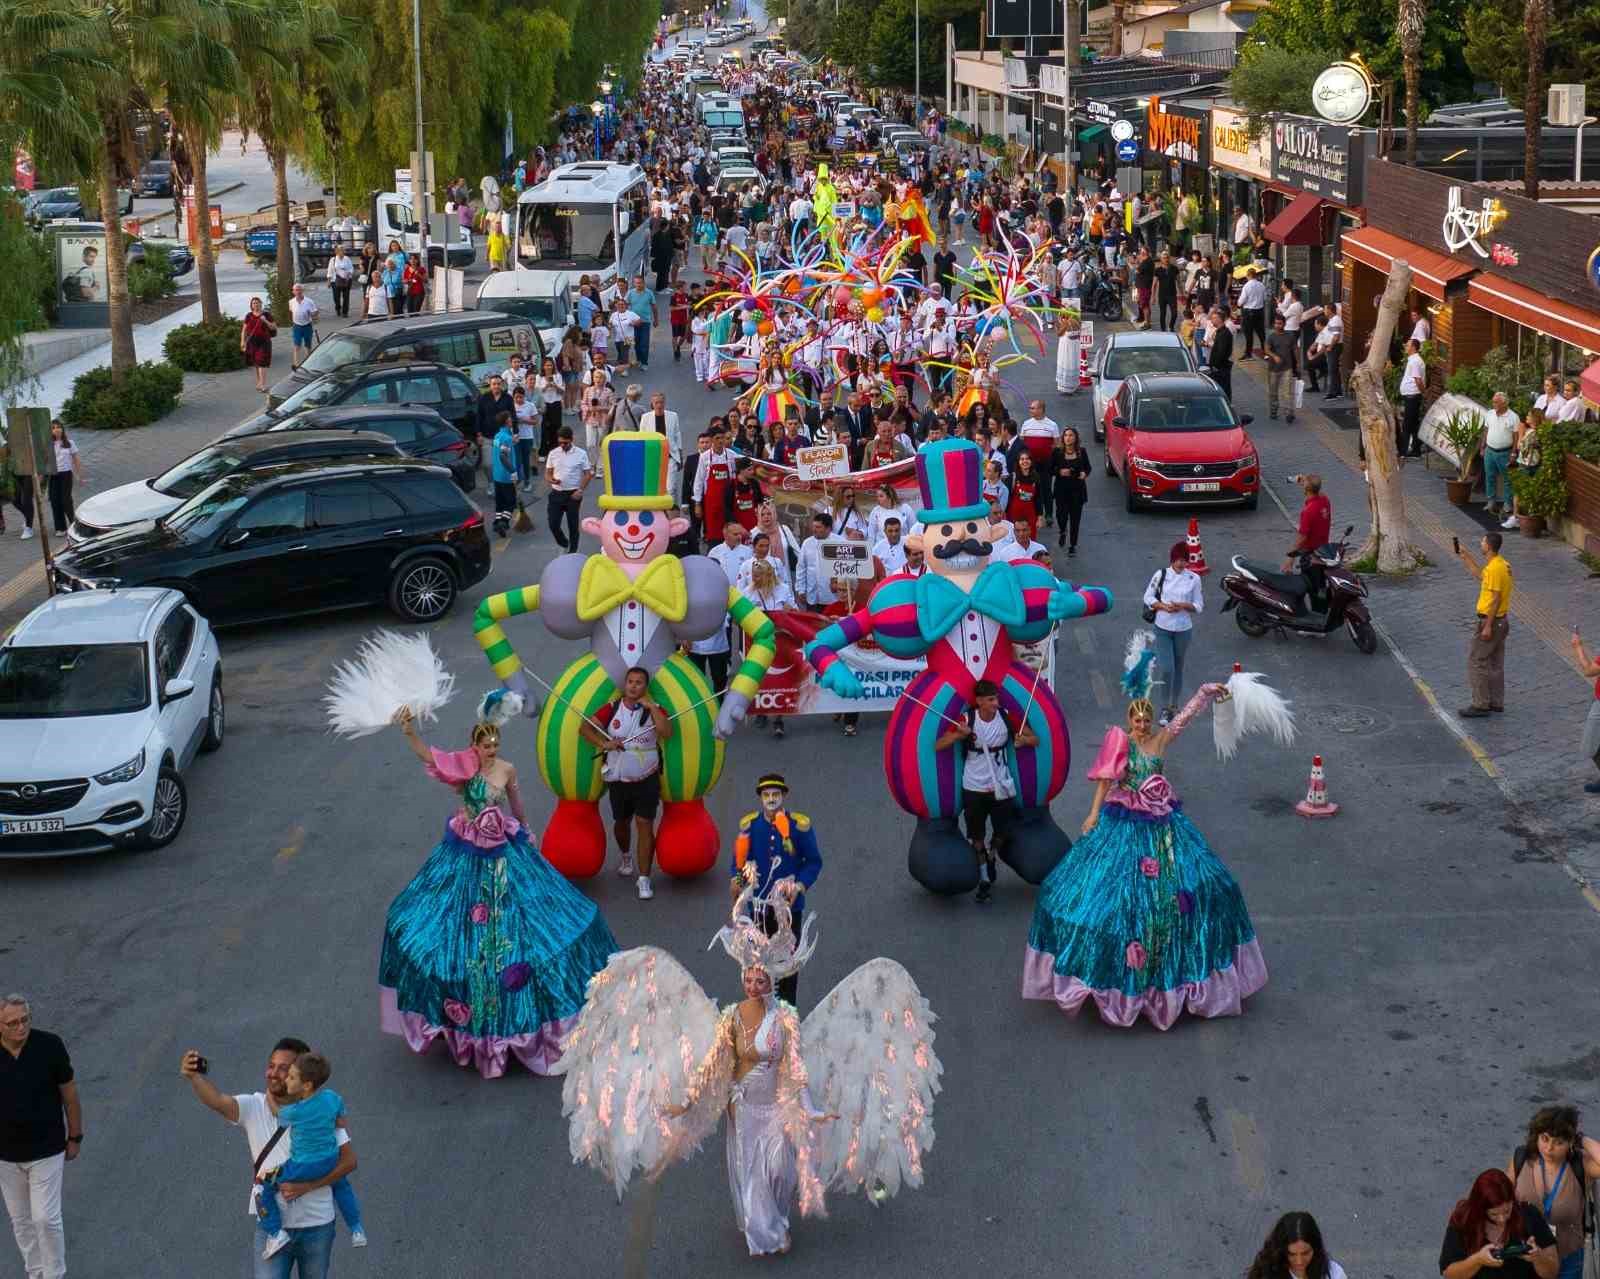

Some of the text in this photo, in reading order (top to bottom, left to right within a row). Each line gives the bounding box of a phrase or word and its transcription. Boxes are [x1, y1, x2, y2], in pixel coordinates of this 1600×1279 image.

[1148, 95, 1199, 153] STATION
[804, 448, 840, 459] FLAVOR
[810, 463, 835, 479] Street
[836, 545, 855, 553] ART
[833, 560, 861, 576] Street
[4, 821, 61, 833] 34 EAJ 932
